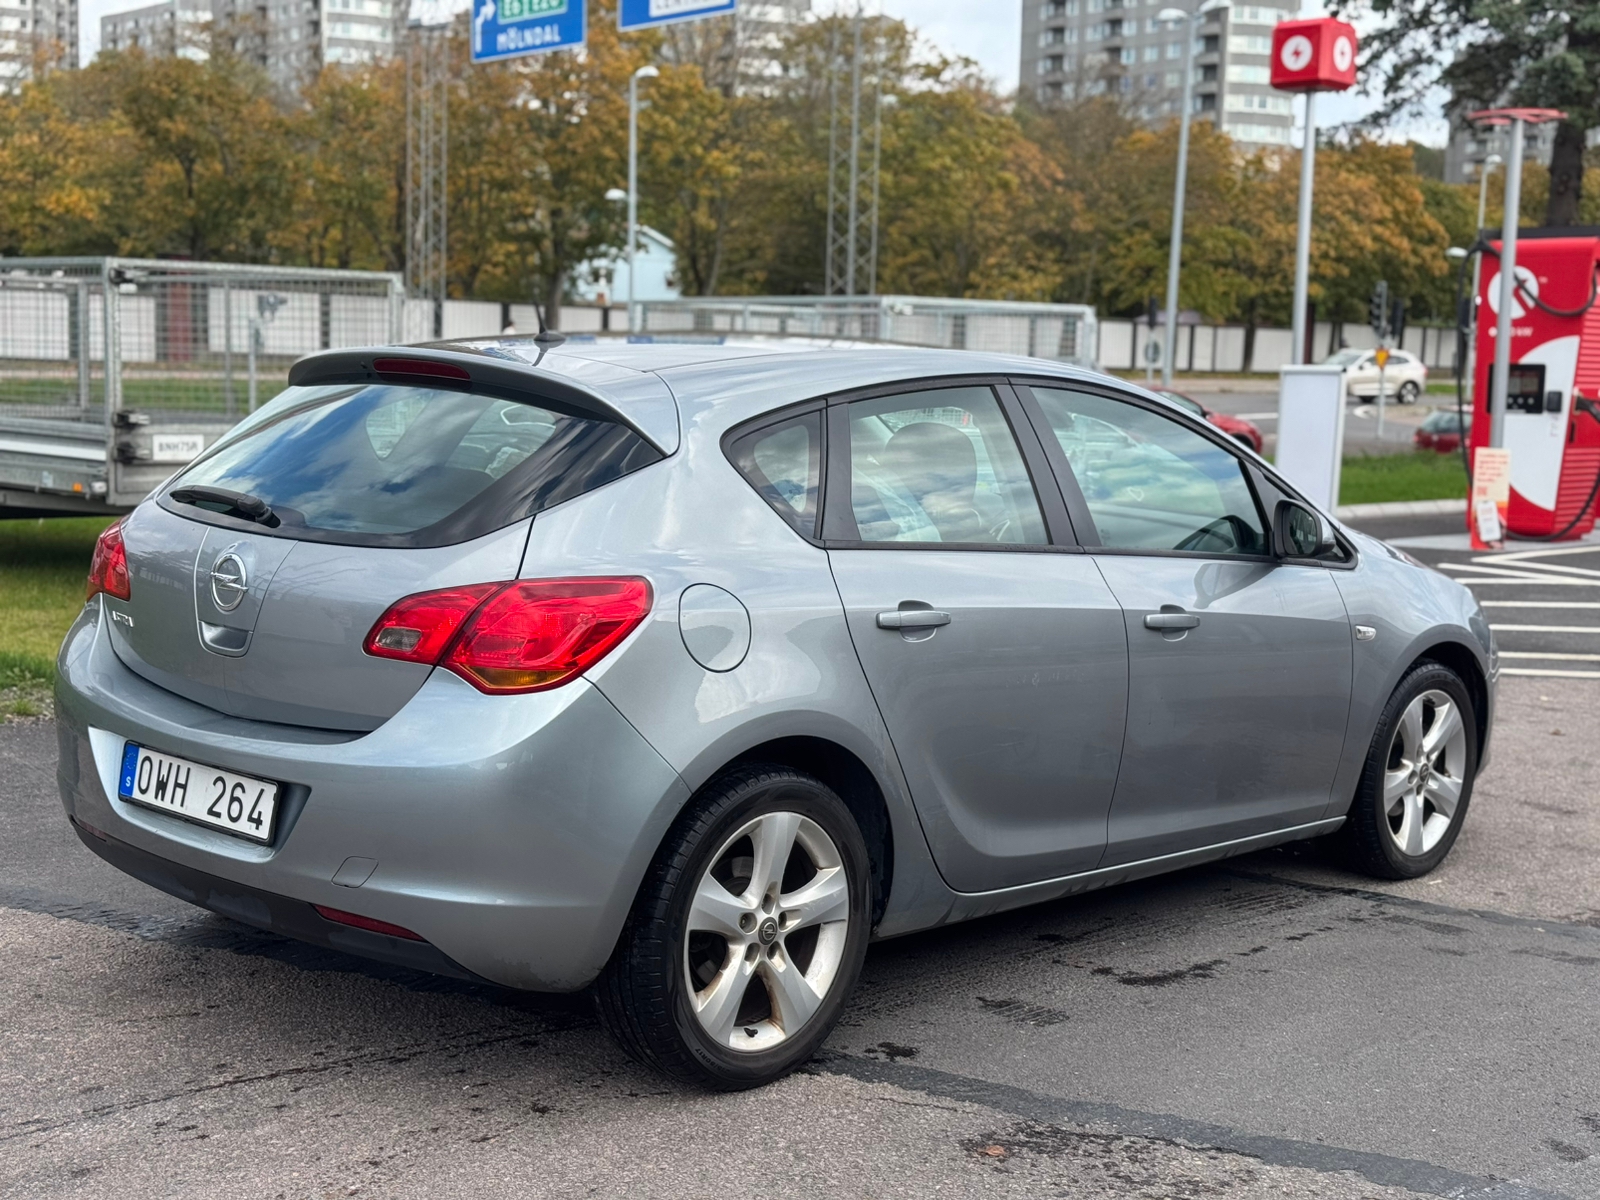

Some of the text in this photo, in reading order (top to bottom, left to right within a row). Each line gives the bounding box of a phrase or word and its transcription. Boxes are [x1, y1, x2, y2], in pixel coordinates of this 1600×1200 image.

[496, 23, 561, 51] MÖLNDAL
[125, 776, 132, 787] S
[137, 755, 265, 831] OWH 264
